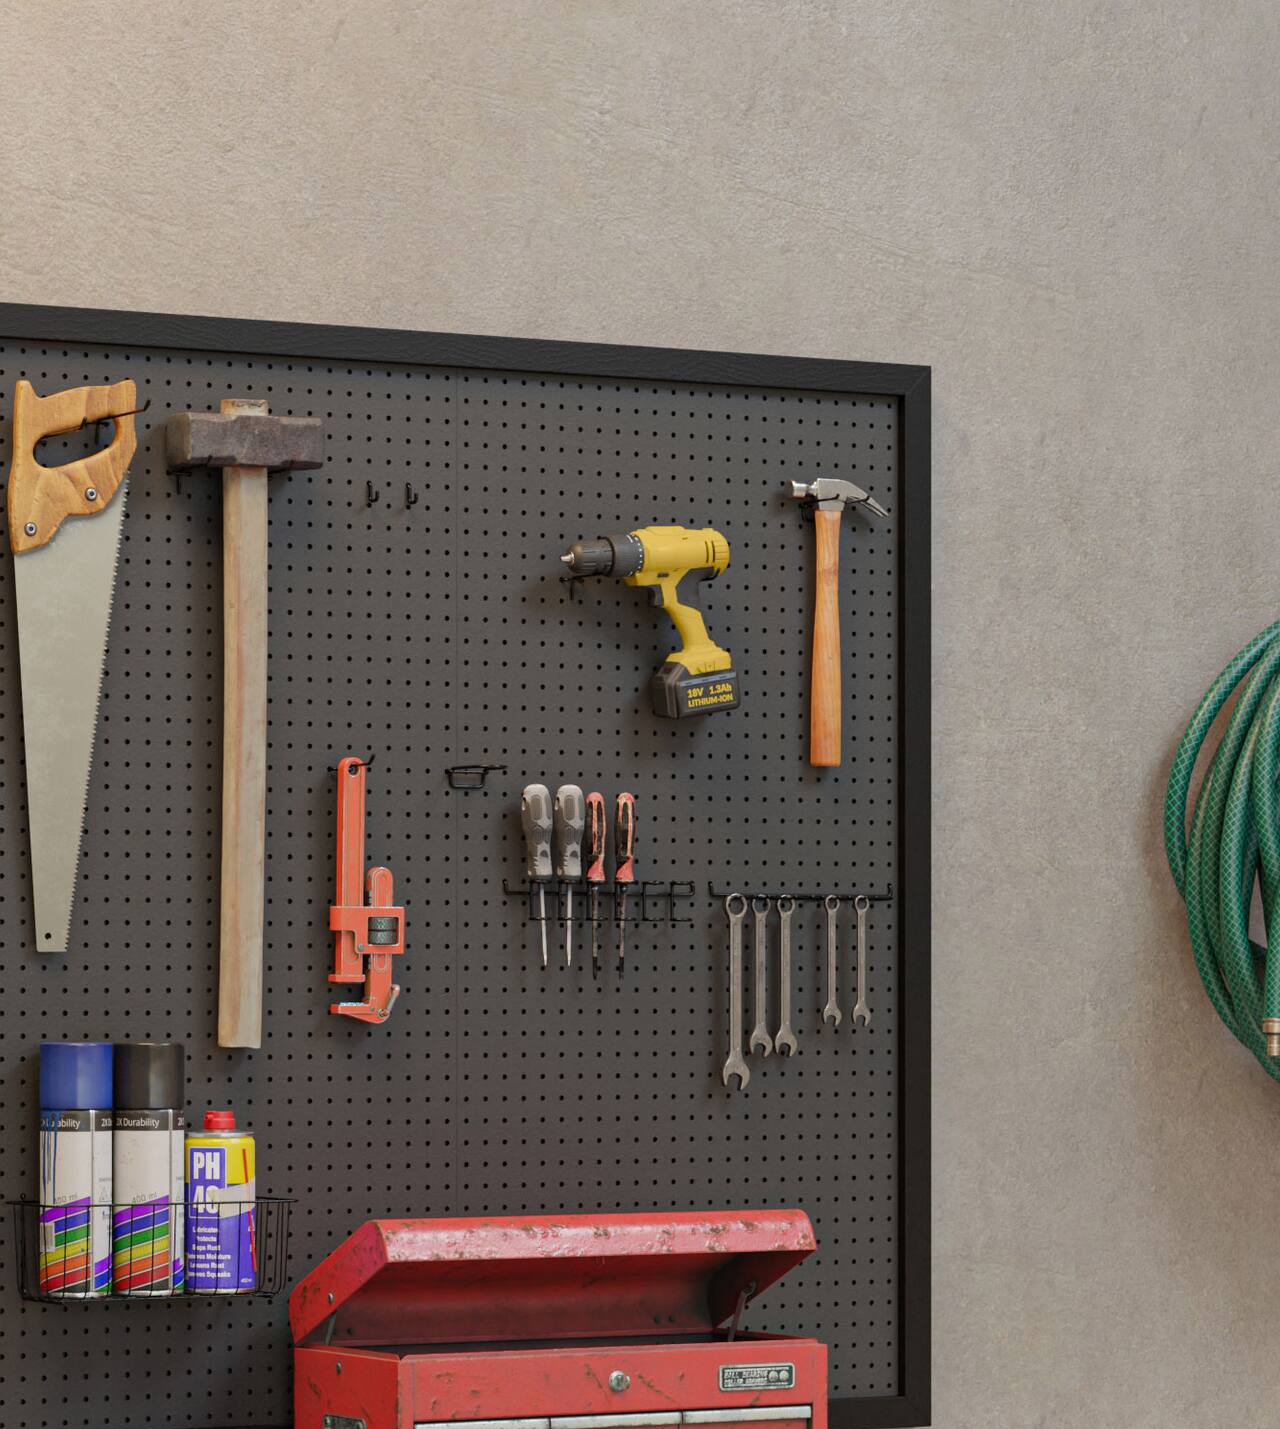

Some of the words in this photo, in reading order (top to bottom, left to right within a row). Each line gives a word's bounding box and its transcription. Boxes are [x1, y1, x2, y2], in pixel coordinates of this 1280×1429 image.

[687, 687, 704, 698] 18V
[709, 682, 732, 694] 1.3Ah
[687, 693, 734, 708] LITHIUM-ION
[123, 1117, 160, 1129] Durability
[193, 1151, 220, 1180] PH
